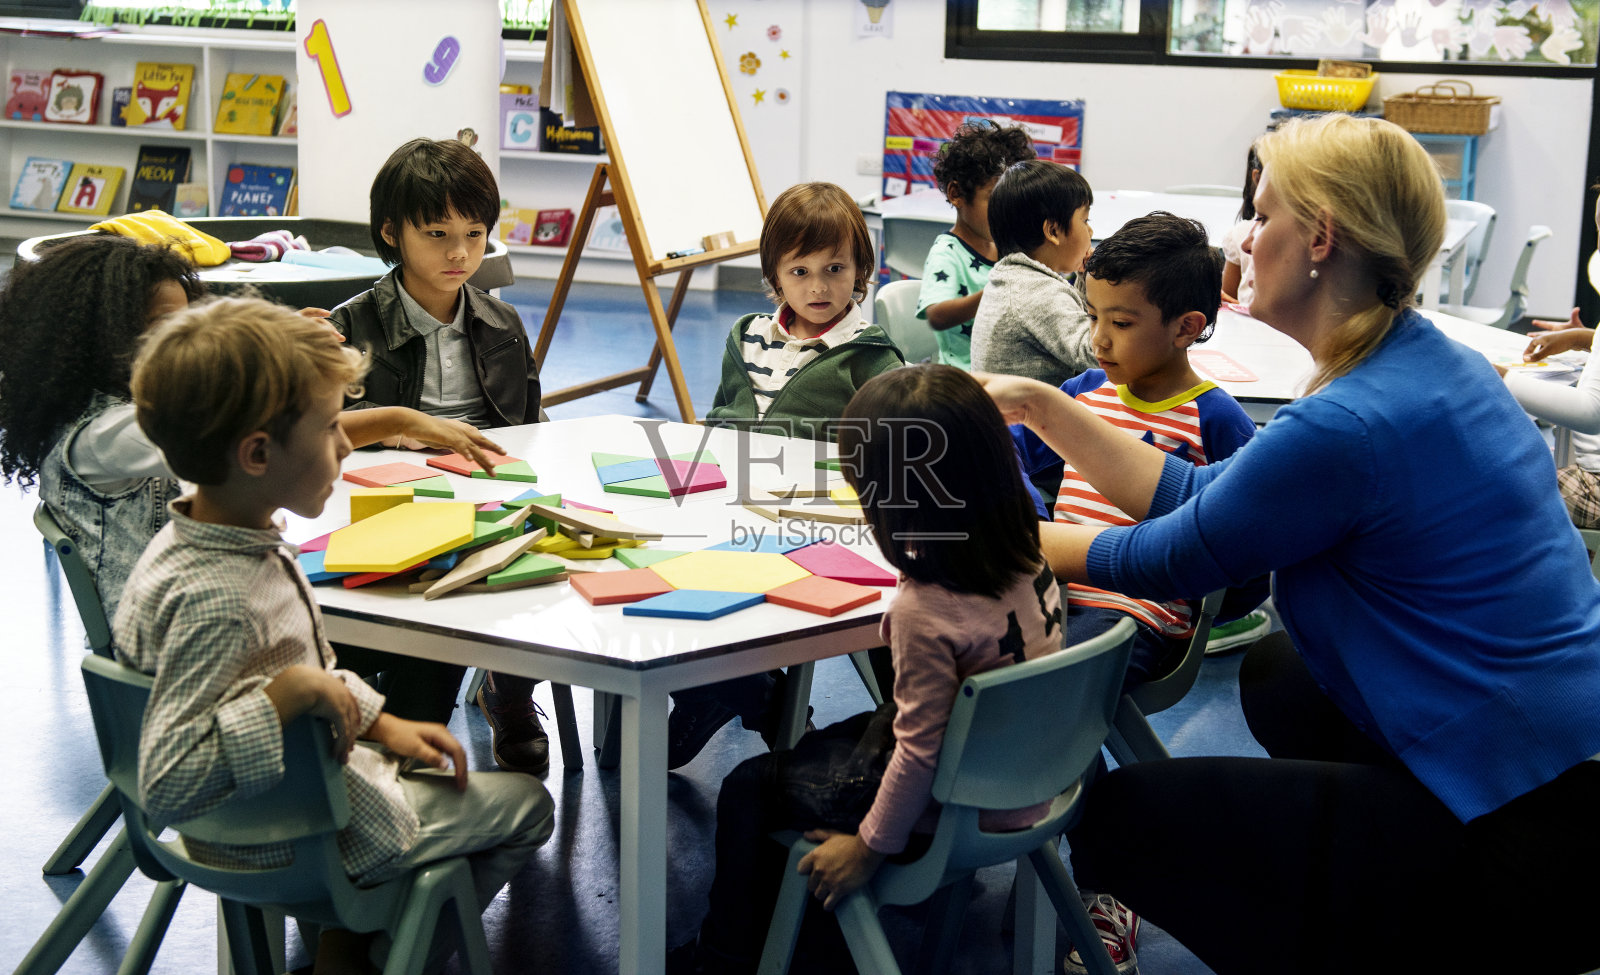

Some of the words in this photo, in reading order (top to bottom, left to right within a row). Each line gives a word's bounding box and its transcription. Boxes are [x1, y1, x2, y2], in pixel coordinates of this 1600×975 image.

[304, 18, 352, 119] 1
[423, 34, 461, 86] 9
[136, 165, 175, 182] MEOW
[230, 190, 274, 205] PLANET
